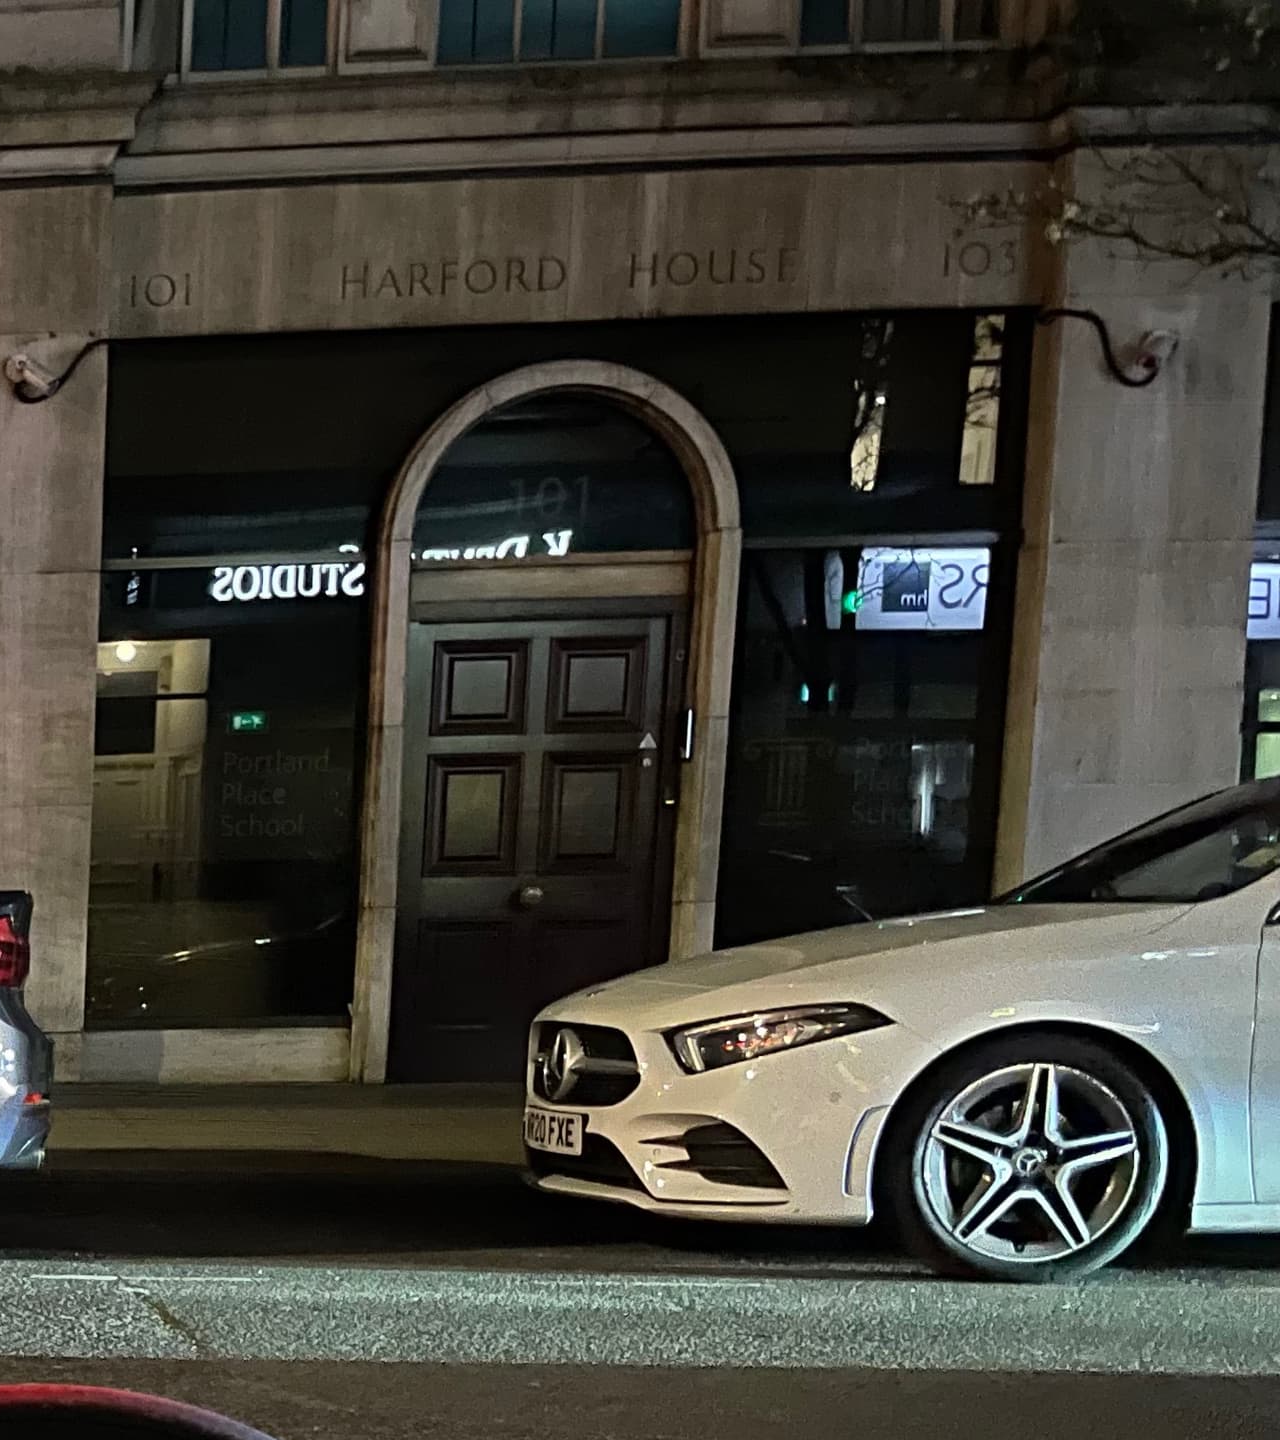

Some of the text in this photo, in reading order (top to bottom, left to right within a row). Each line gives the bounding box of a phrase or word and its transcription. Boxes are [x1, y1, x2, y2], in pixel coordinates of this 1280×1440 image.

[340, 246, 800, 299] HARFORD HOUSE
[548, 1115, 575, 1148] FXE
